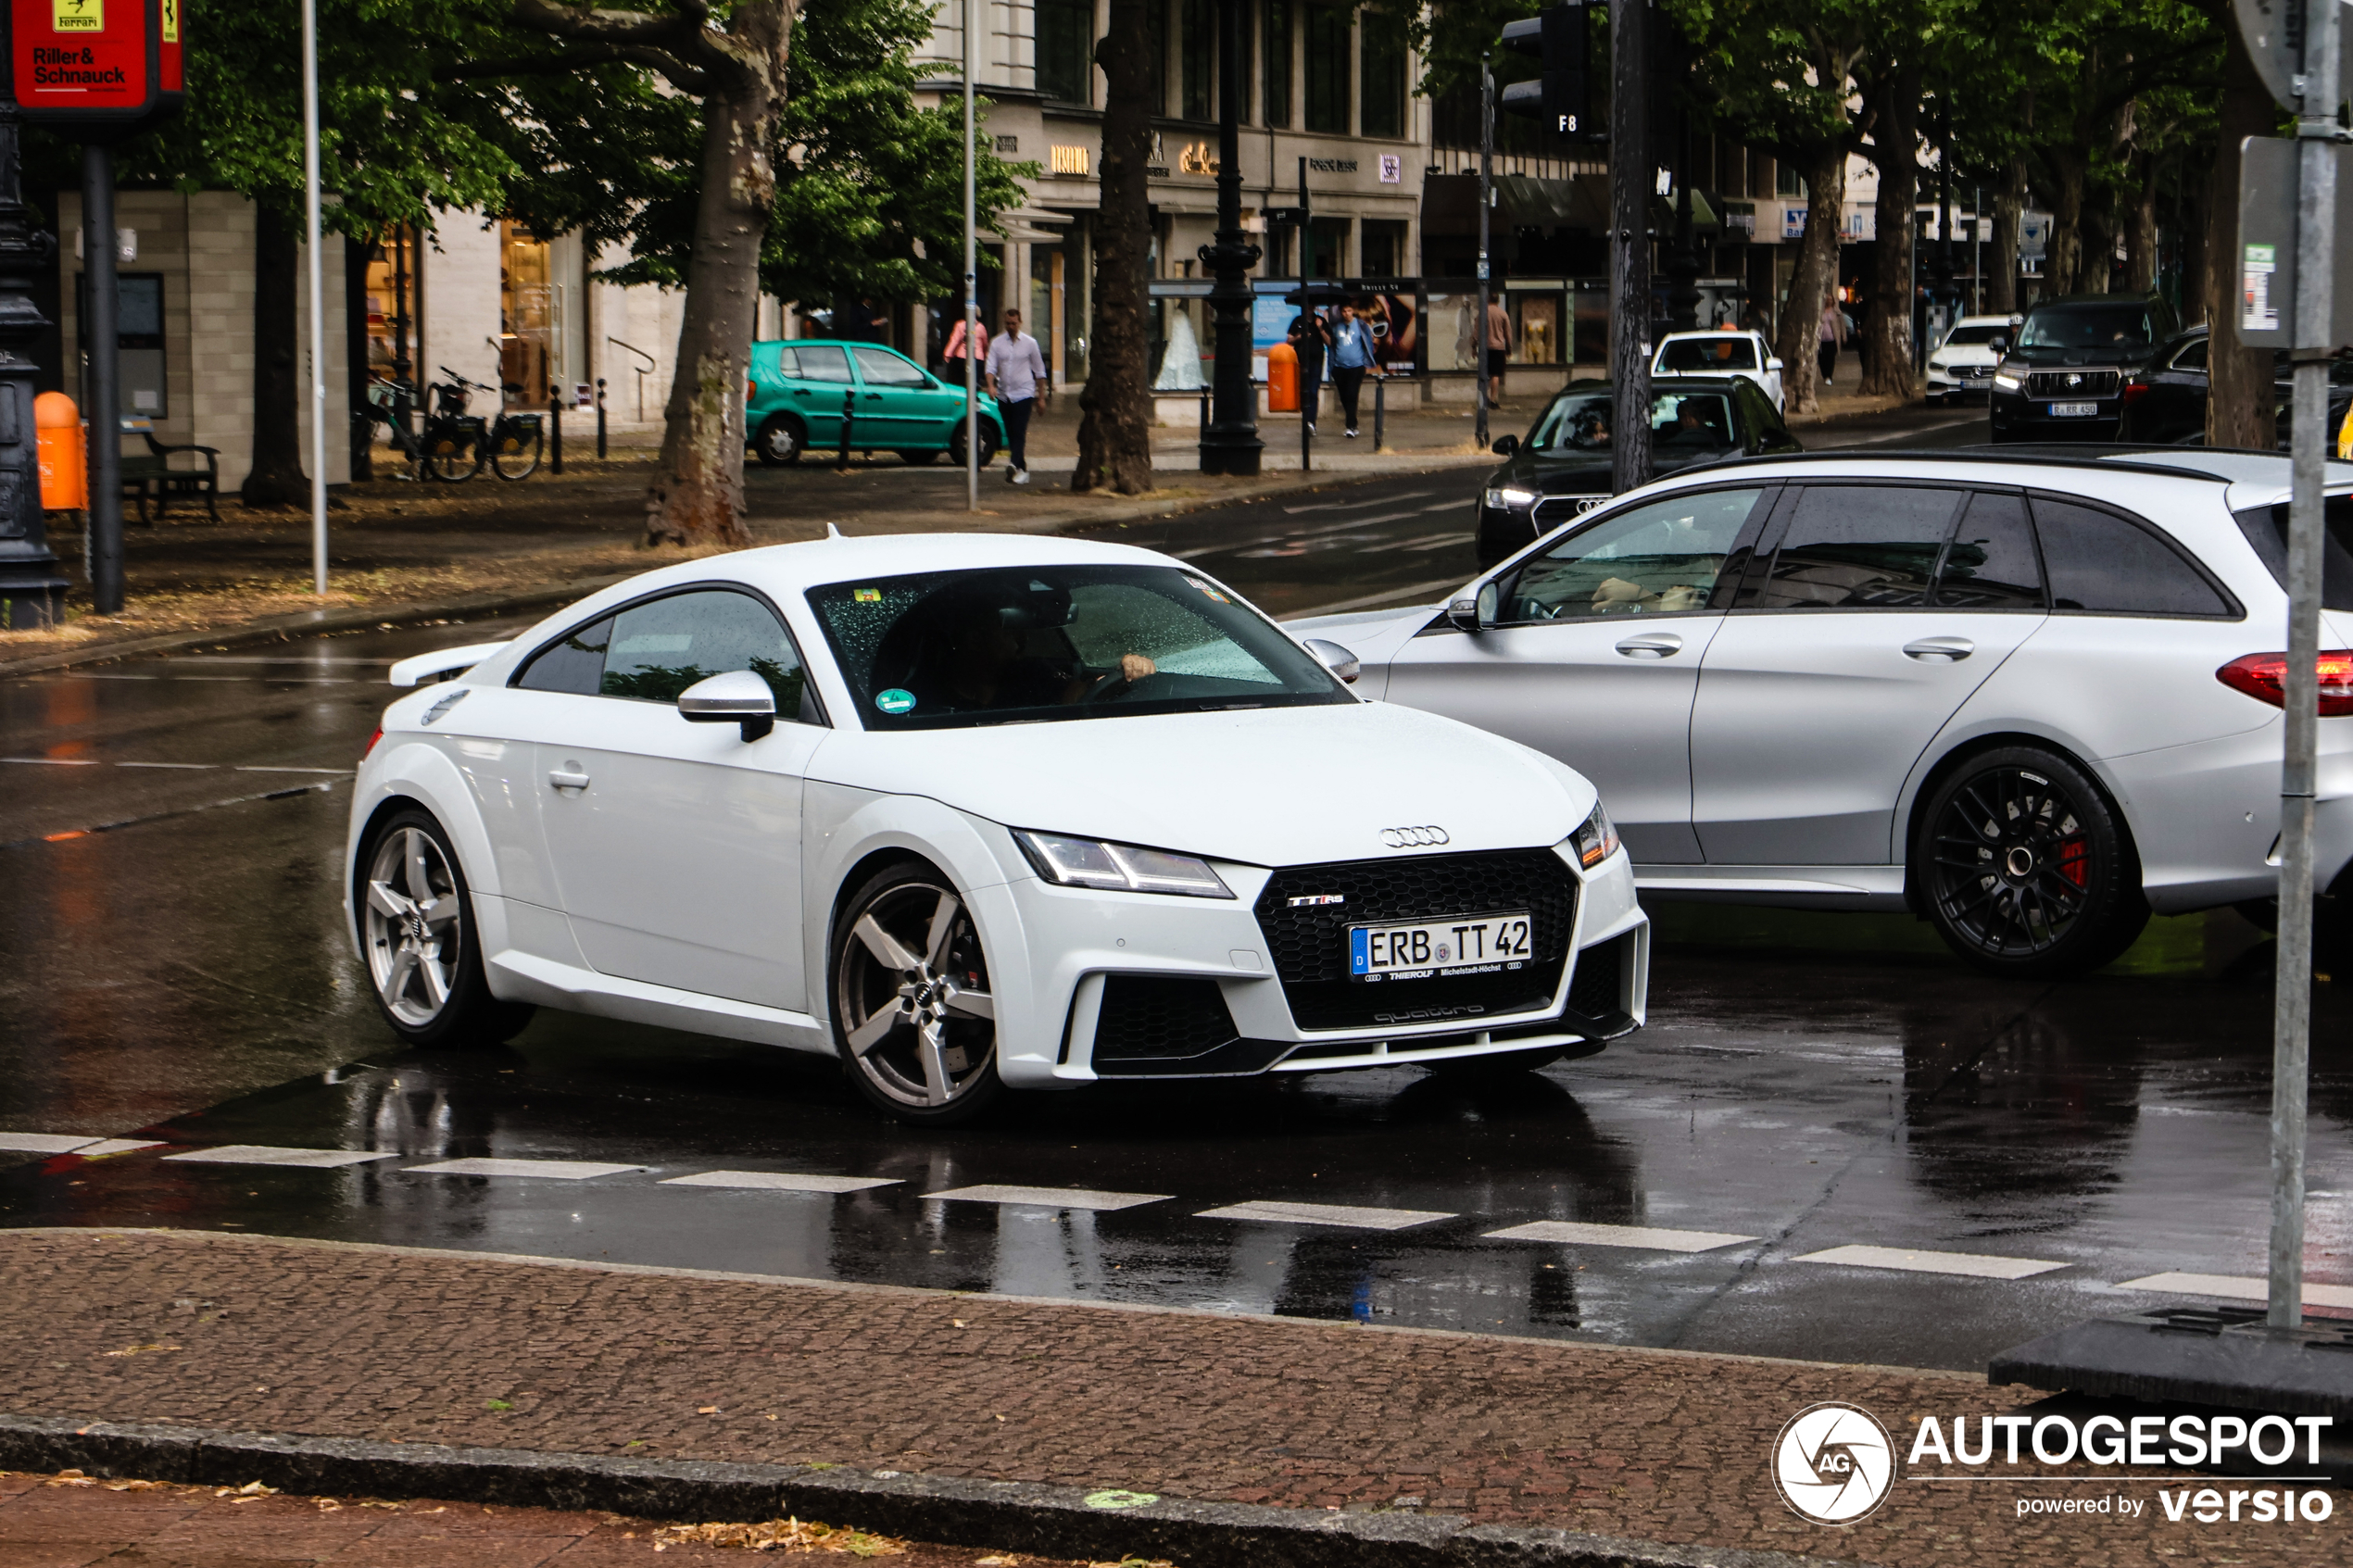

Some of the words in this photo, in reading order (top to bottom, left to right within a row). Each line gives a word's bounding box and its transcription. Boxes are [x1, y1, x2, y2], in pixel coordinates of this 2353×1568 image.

[58, 16, 97, 28] Ferrari
[33, 48, 79, 65] Riller
[81, 47, 94, 65] &
[34, 67, 126, 84] Schnauck
[1558, 114, 1577, 132] F8
[1356, 956, 1364, 966] D
[1370, 929, 1431, 967] ERB
[1452, 924, 1488, 960] TT
[1495, 921, 1529, 956] 42
[1389, 970, 1434, 980] THIEROLF
[1441, 964, 1502, 976] Michelstadt-Höchst
[1374, 1005, 1485, 1023] quattro
